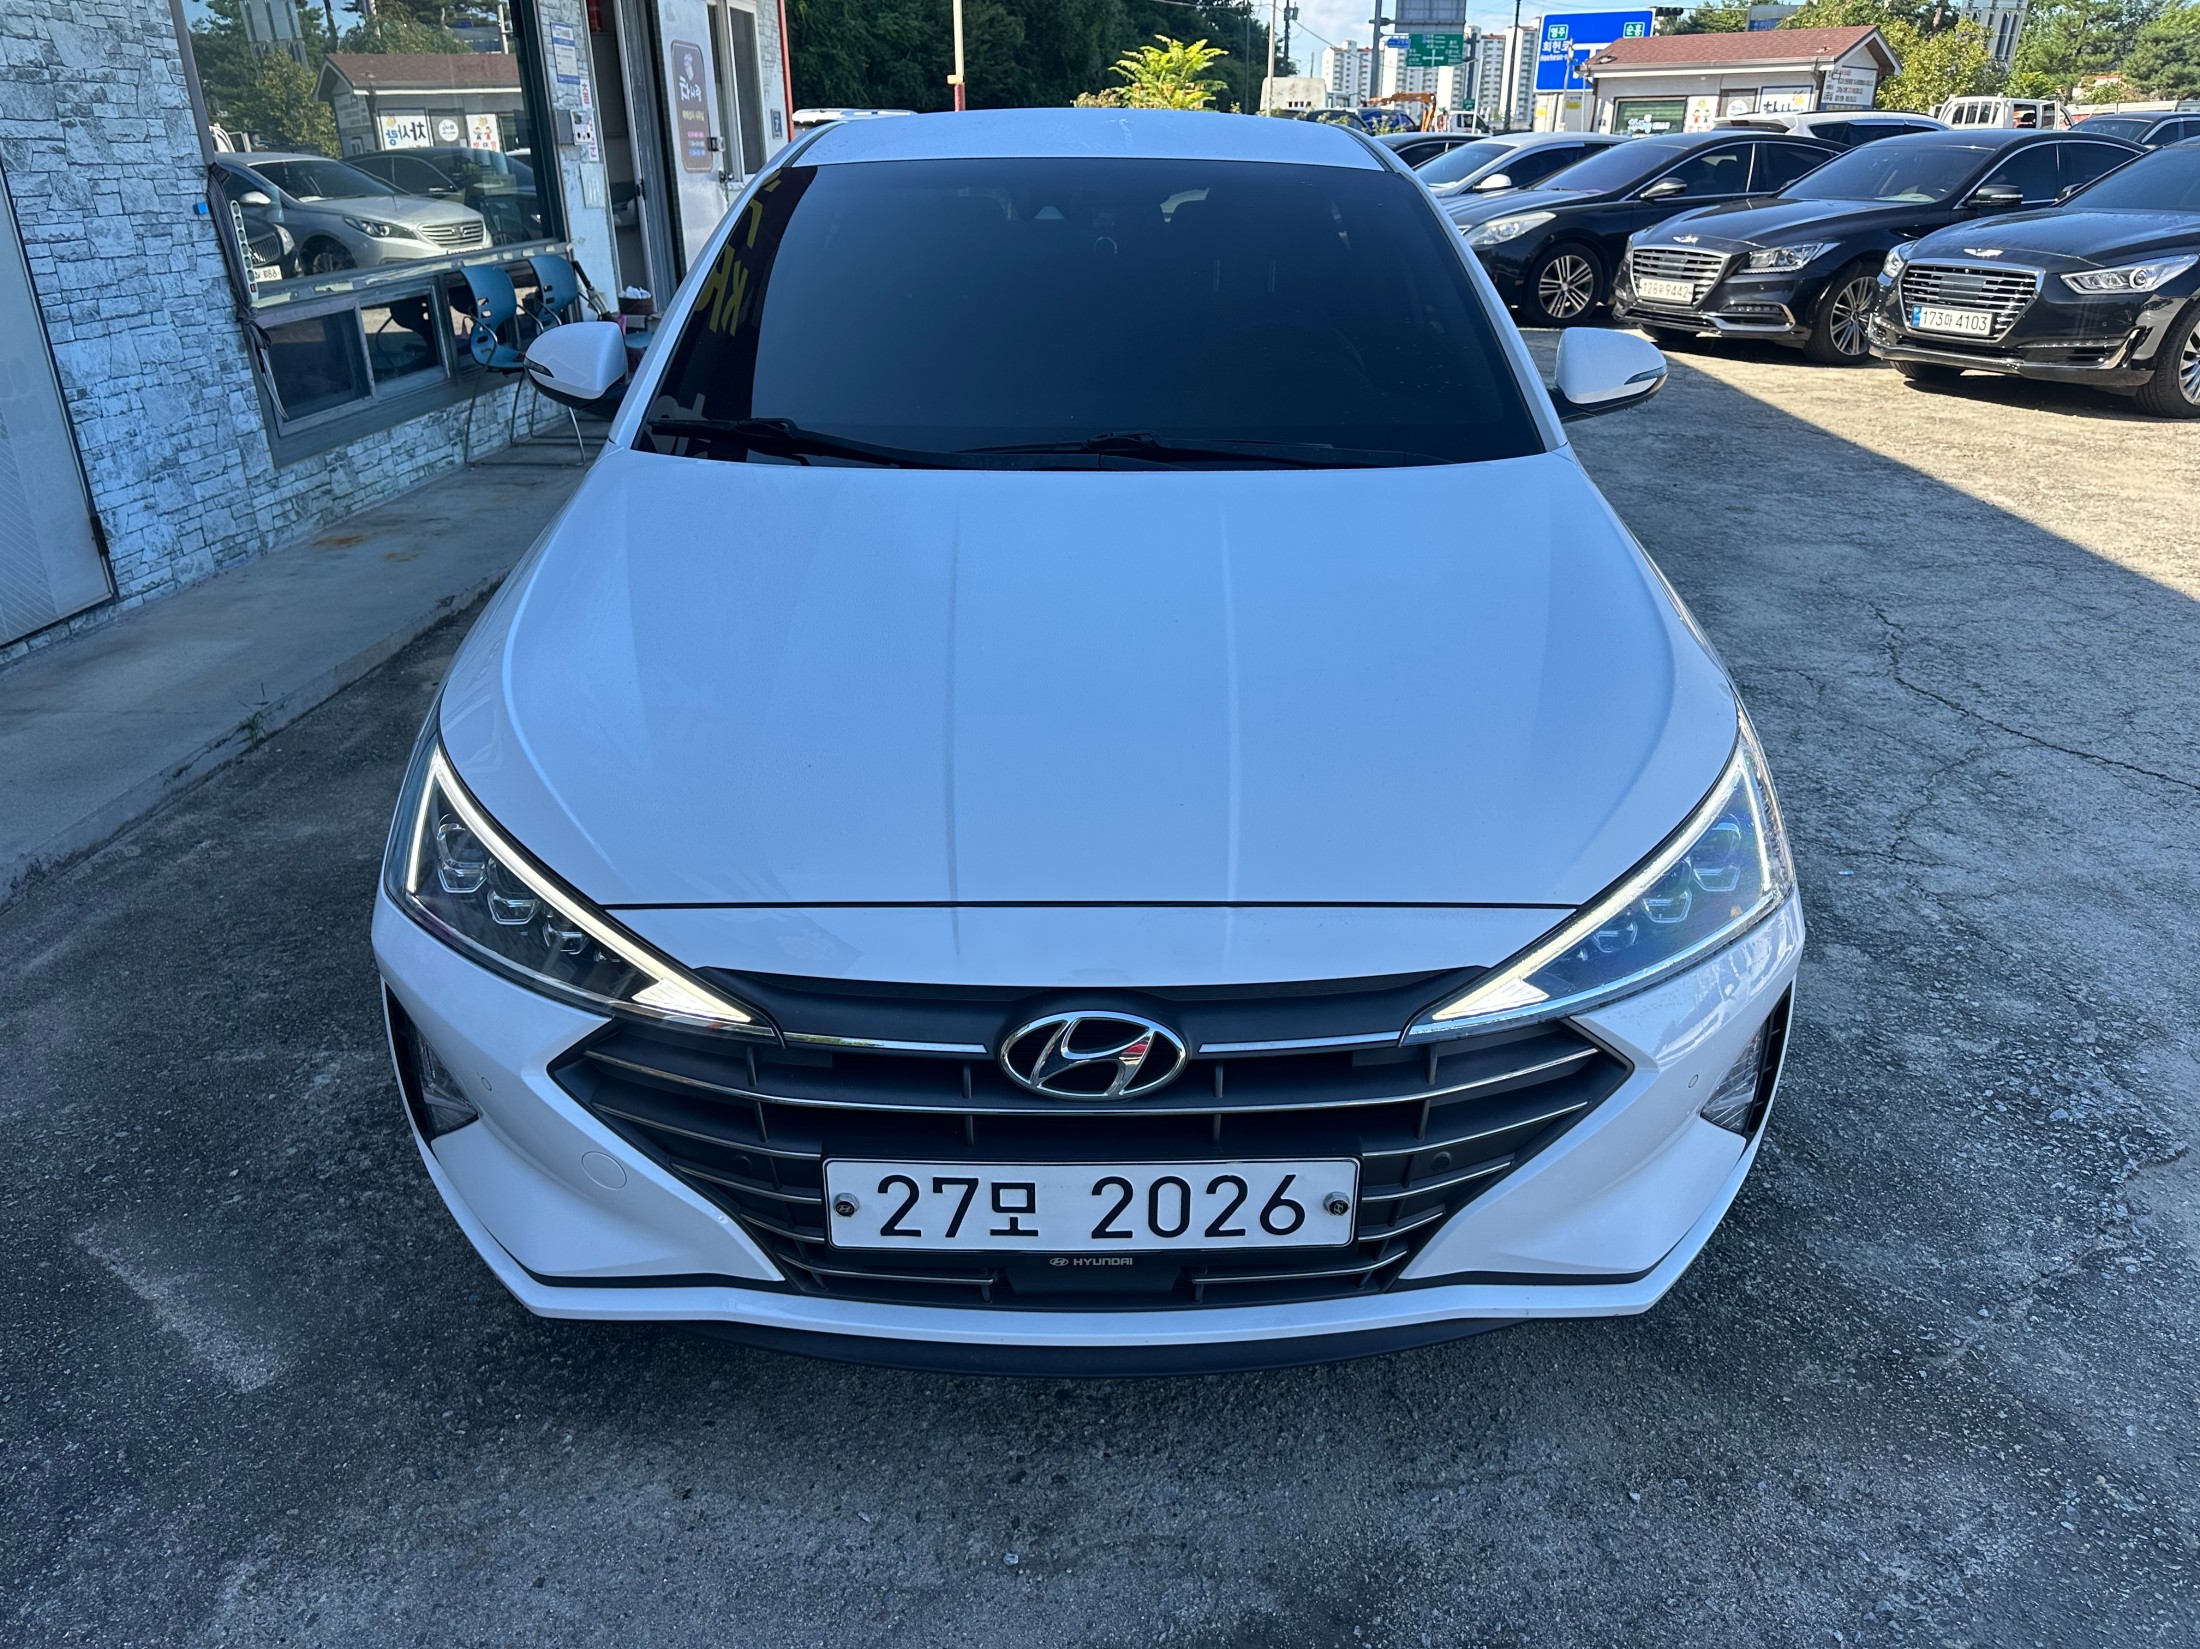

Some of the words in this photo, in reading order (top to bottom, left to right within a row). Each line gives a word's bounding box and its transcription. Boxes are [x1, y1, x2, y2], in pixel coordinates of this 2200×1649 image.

[1665, 284, 1690, 299] 9442
[1955, 314, 1988, 331] 4103
[876, 1173, 1040, 1239] 27모
[1090, 1173, 1306, 1239] 2026
[1073, 1257, 1133, 1266] HYUNDAI
